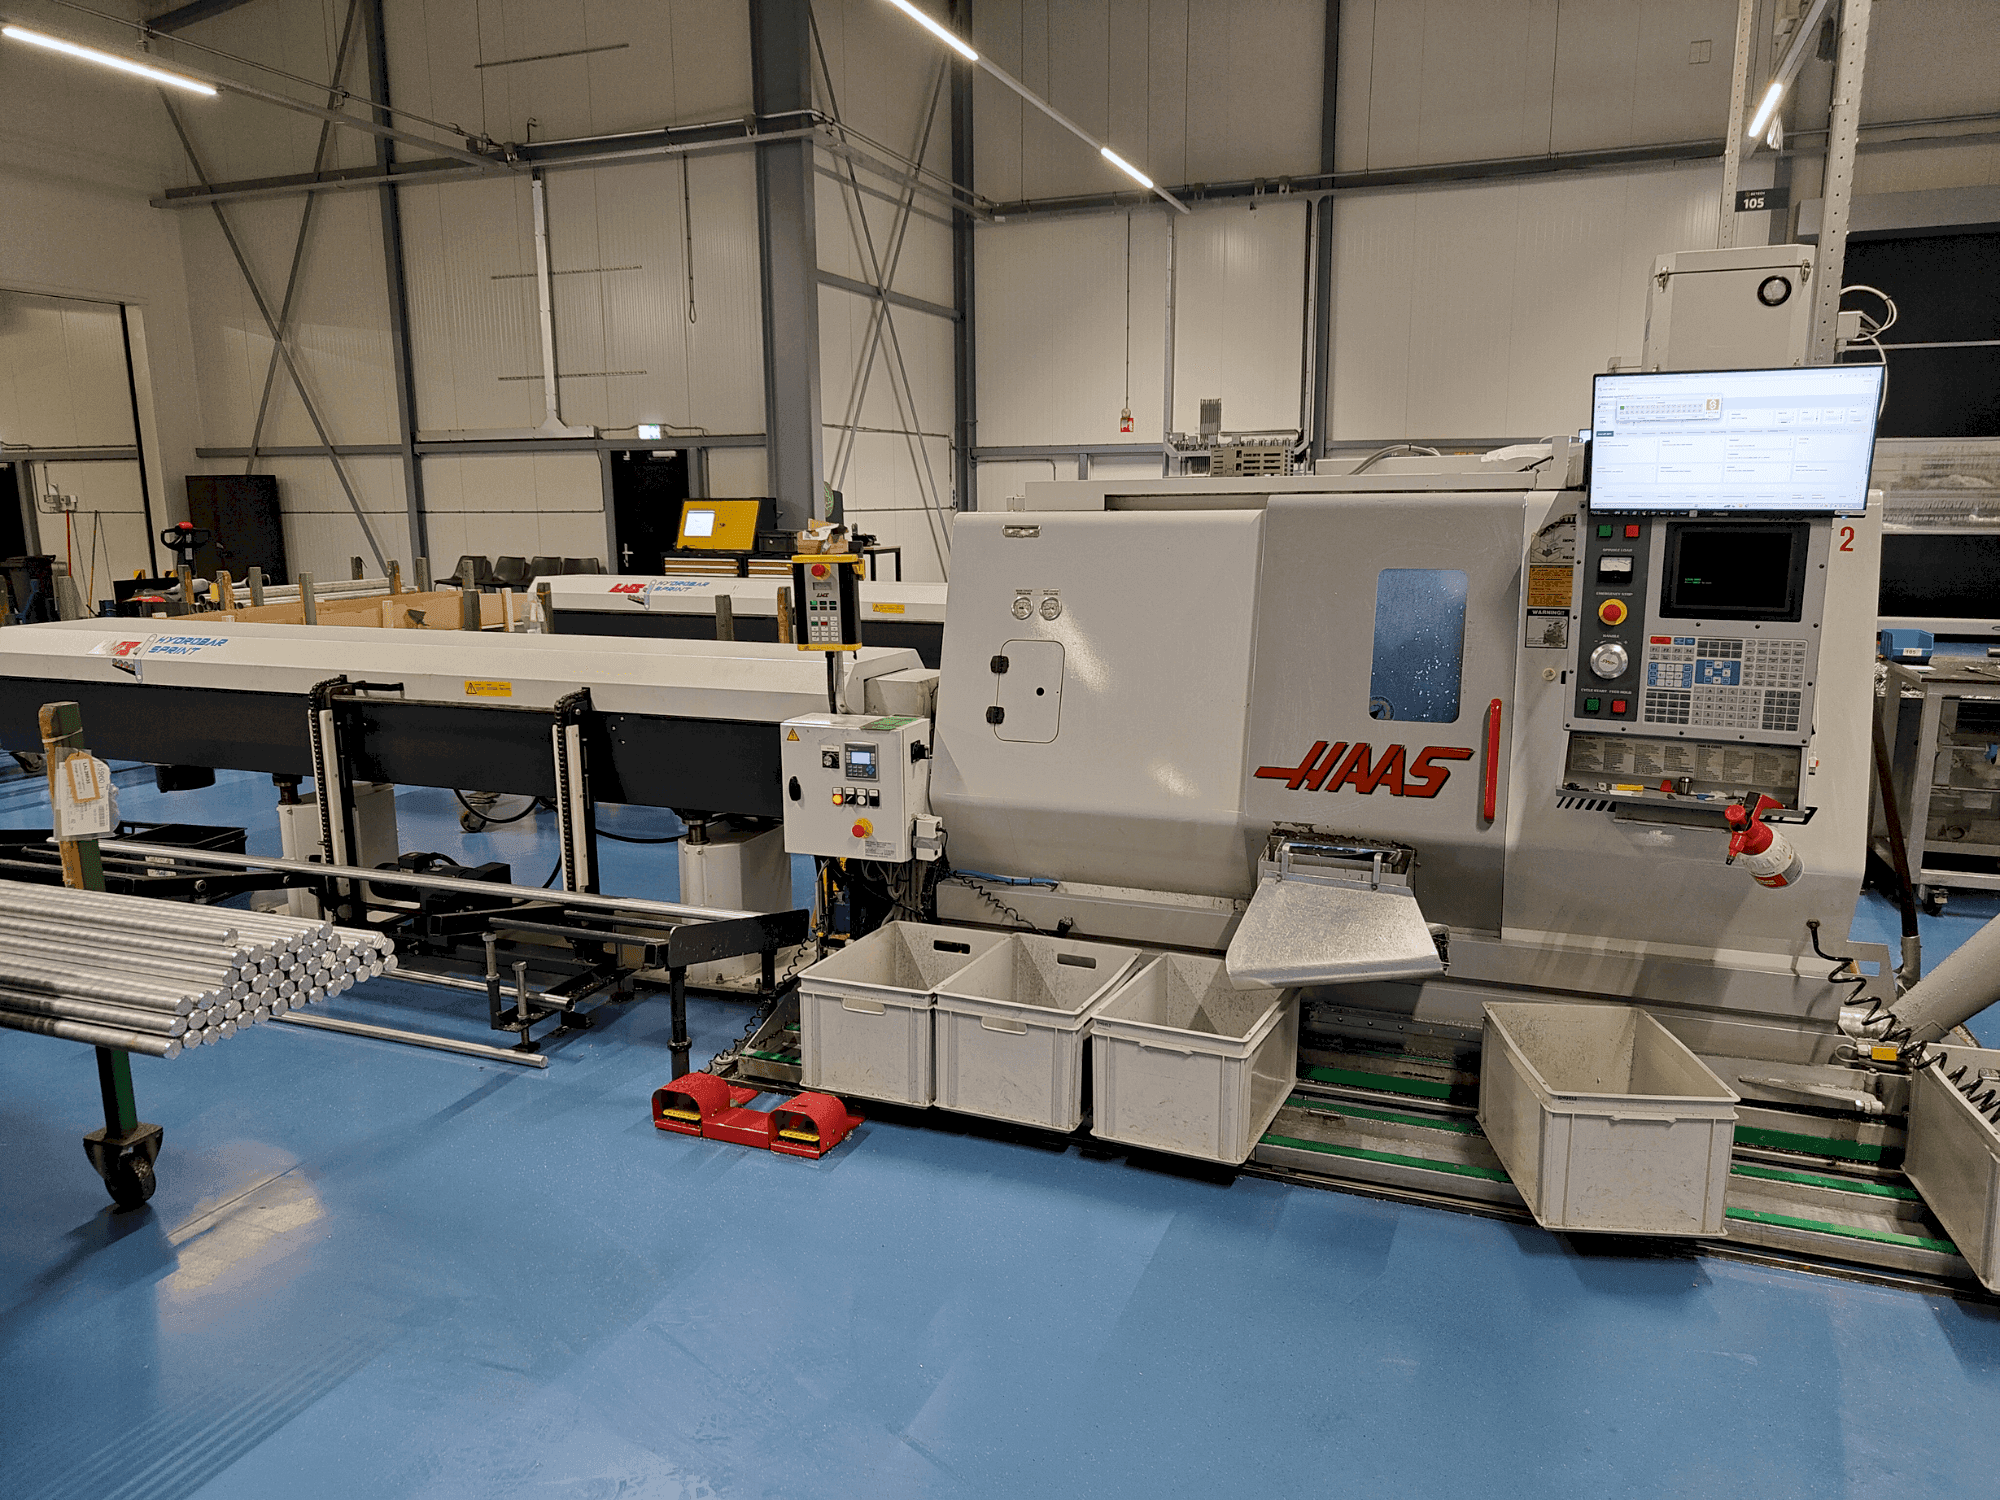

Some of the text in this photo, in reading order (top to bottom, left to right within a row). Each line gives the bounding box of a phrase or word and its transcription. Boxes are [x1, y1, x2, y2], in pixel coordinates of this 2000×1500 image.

[1743, 197, 1765, 209] 105
[1839, 526, 1855, 552] 2
[156, 635, 229, 647] HYDROBAR
[148, 645, 202, 656] SPRINT
[1253, 740, 1475, 798] HAAS
